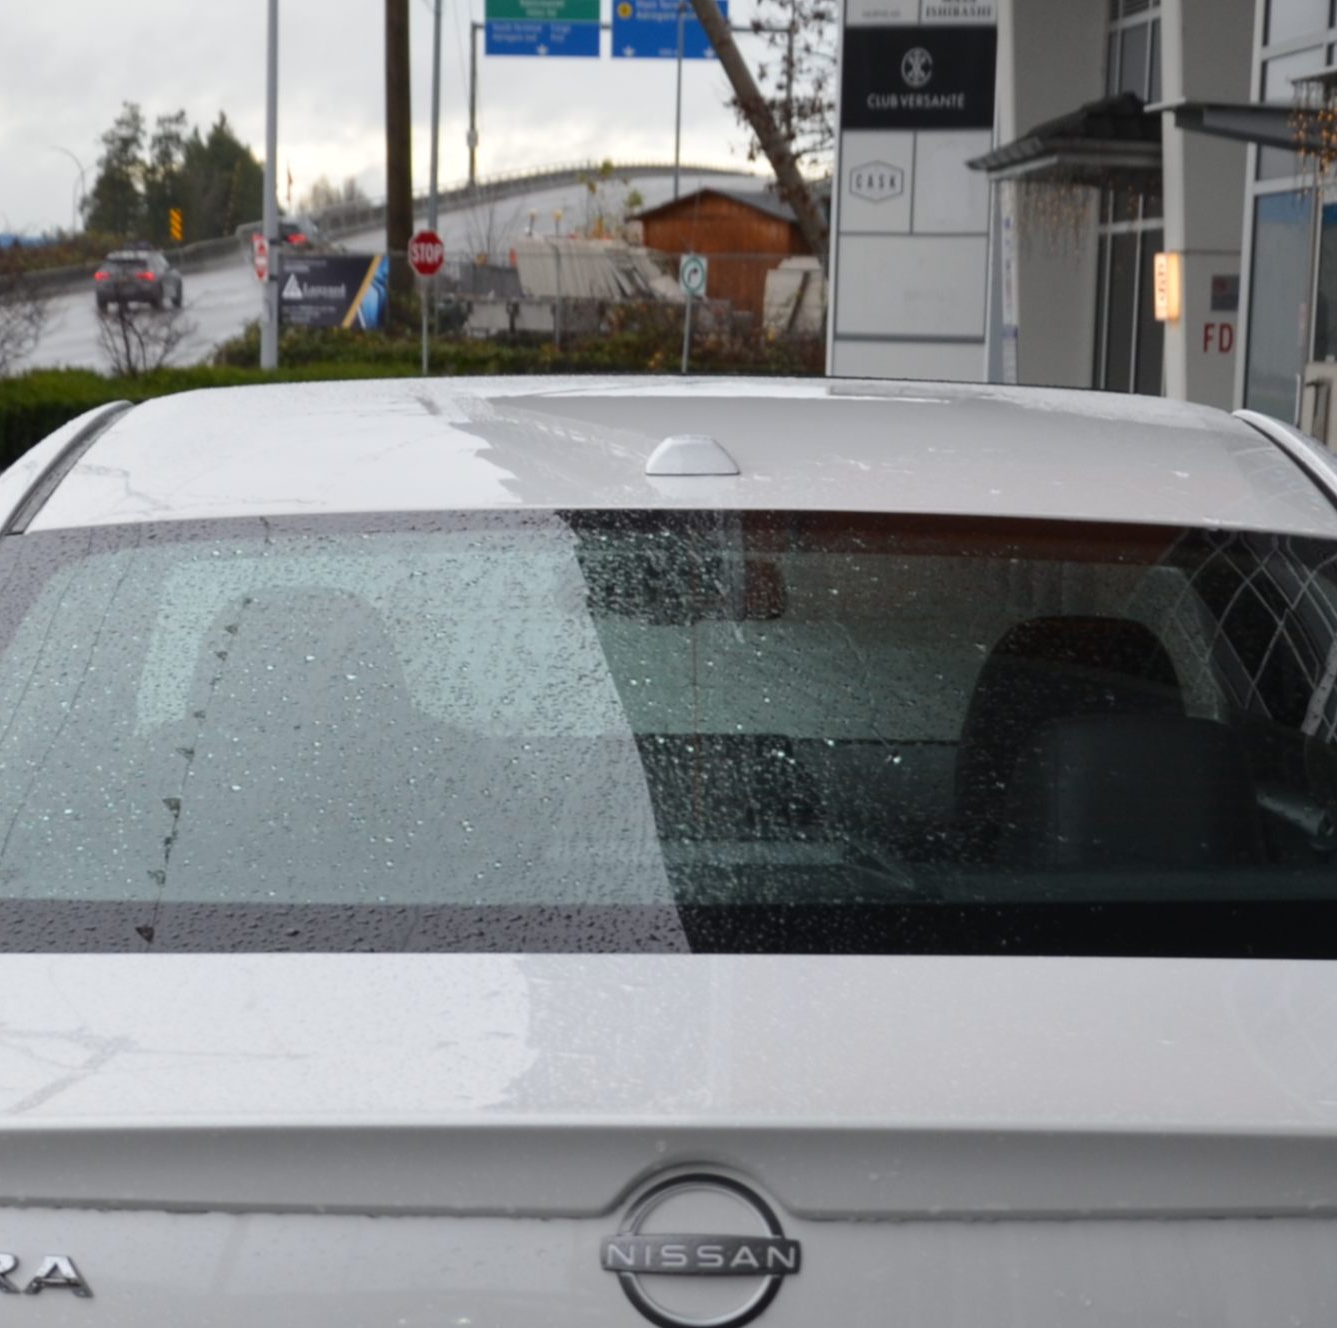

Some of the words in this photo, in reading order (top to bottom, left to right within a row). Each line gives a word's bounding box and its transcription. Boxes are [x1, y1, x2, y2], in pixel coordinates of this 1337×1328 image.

[867, 92, 898, 109] CLUB
[855, 173, 896, 189] CASK
[412, 242, 442, 264] STOP
[1203, 321, 1234, 354] FD
[606, 1243, 796, 1270] NISSAN
